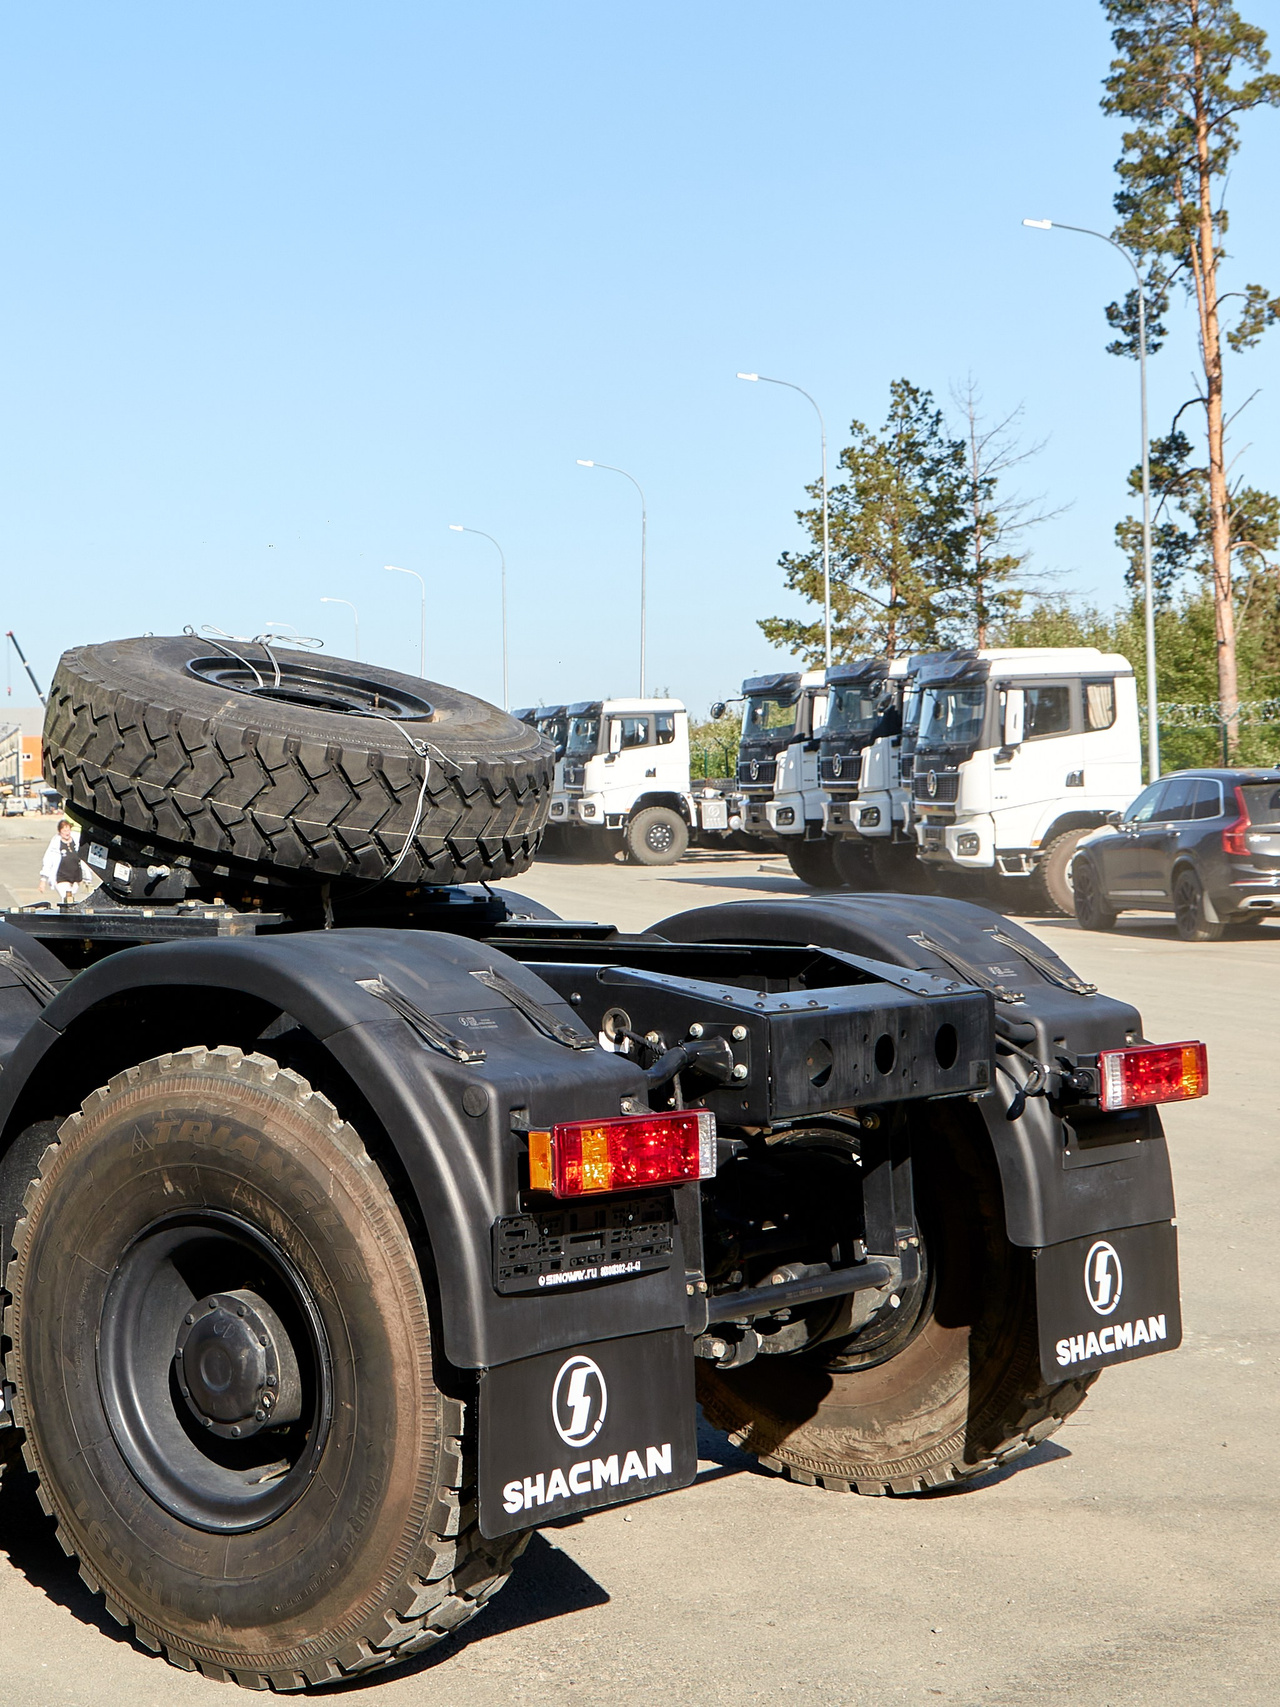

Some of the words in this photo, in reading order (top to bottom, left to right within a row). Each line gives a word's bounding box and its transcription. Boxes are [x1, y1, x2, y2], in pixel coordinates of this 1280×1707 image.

[154, 1118, 371, 1284] TRIANGLE
[1055, 1313, 1167, 1367] SHACMAN
[502, 1442, 673, 1515] SHACMAN
